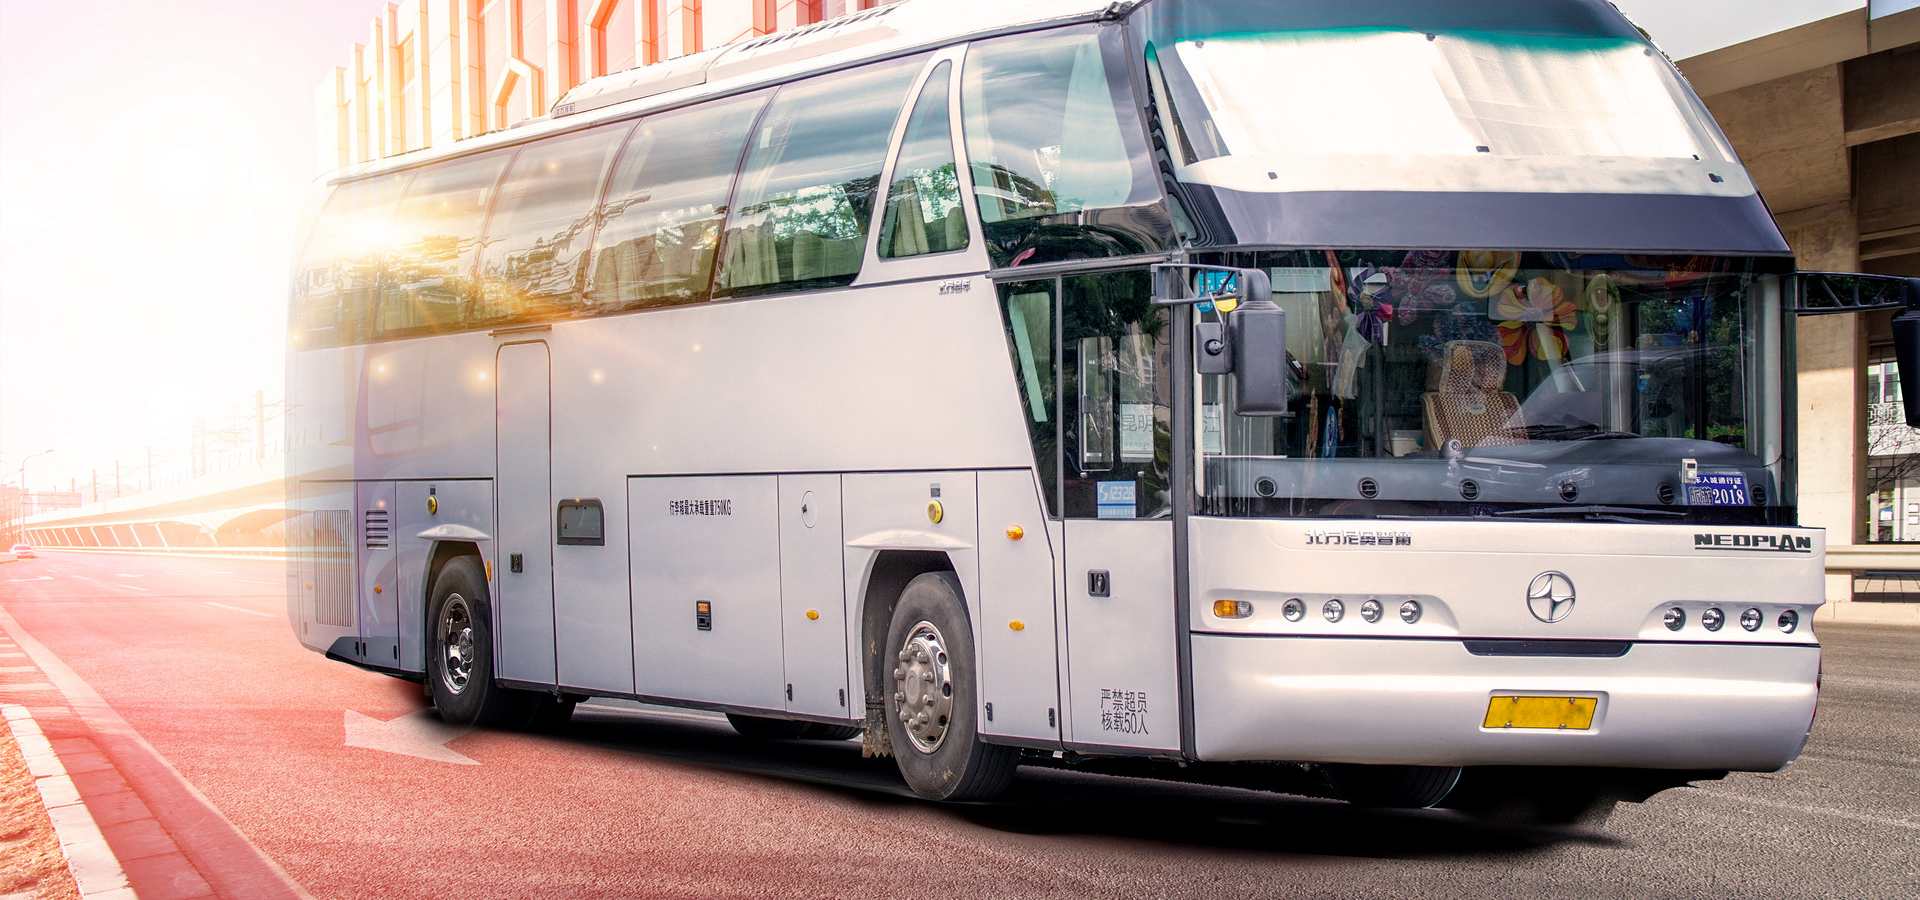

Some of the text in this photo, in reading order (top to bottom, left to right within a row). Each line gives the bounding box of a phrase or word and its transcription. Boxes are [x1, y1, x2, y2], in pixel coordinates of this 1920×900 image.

[1712, 488, 1745, 505] 2018
[1694, 533, 1811, 553] NEOPLAN
[1101, 688, 1148, 713] 严禁超员
[1101, 709, 1149, 735] 核载50人
